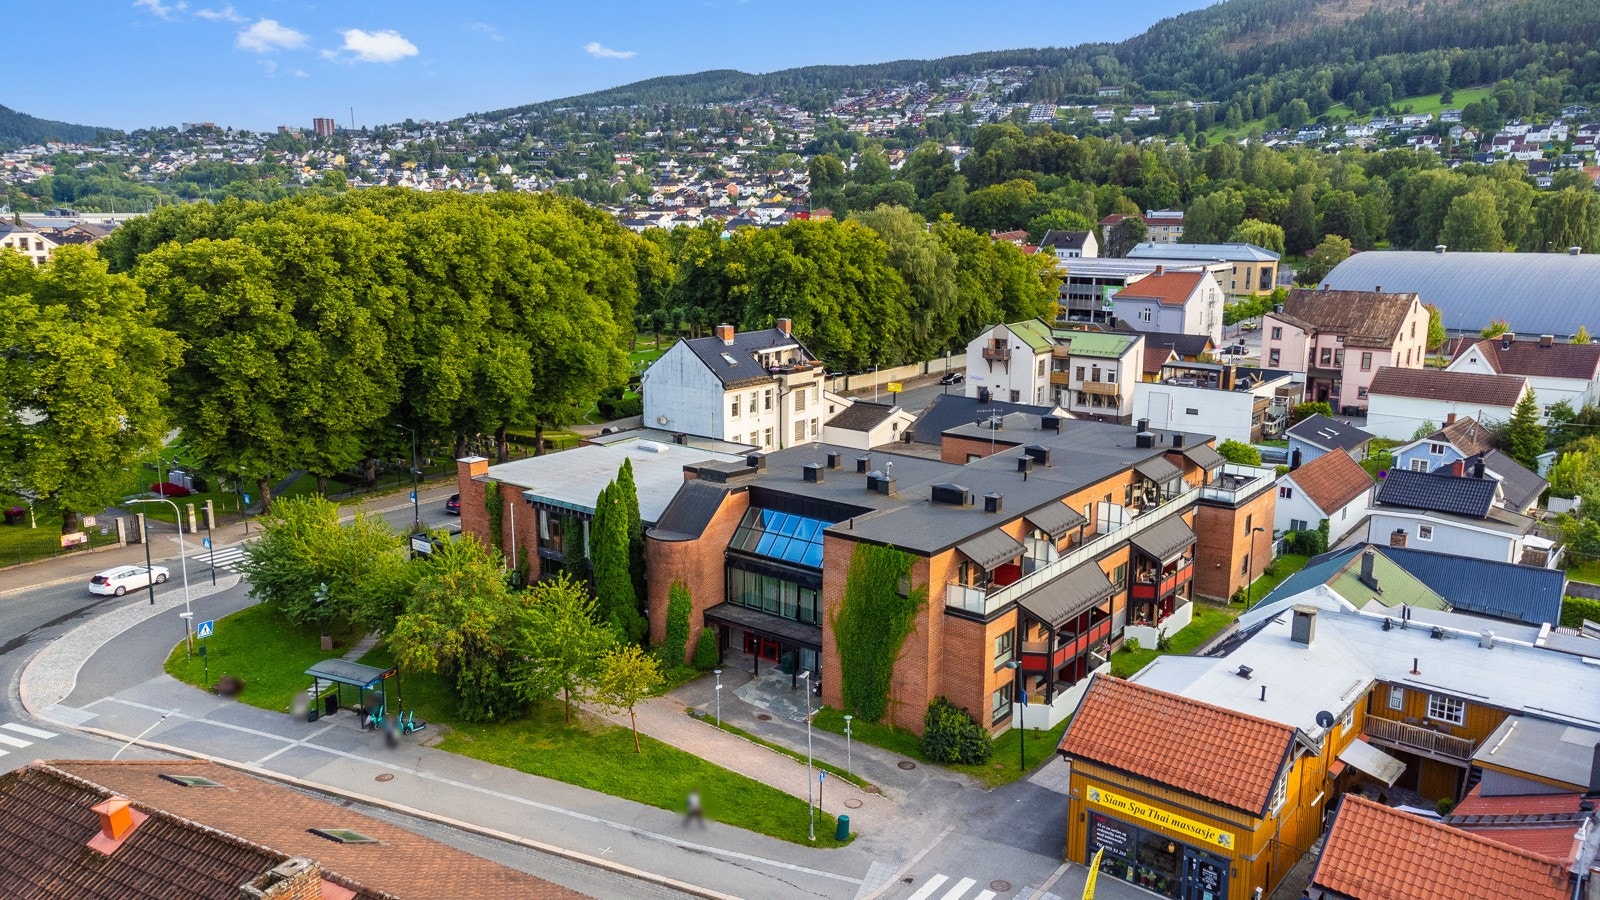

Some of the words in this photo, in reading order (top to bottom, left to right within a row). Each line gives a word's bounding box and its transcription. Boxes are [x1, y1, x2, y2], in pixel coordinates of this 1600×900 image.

[1103, 794, 1126, 808] Siam
[1128, 803, 1146, 816] Spa
[1148, 808, 1170, 824] Thai
[1171, 816, 1215, 839] massasje
